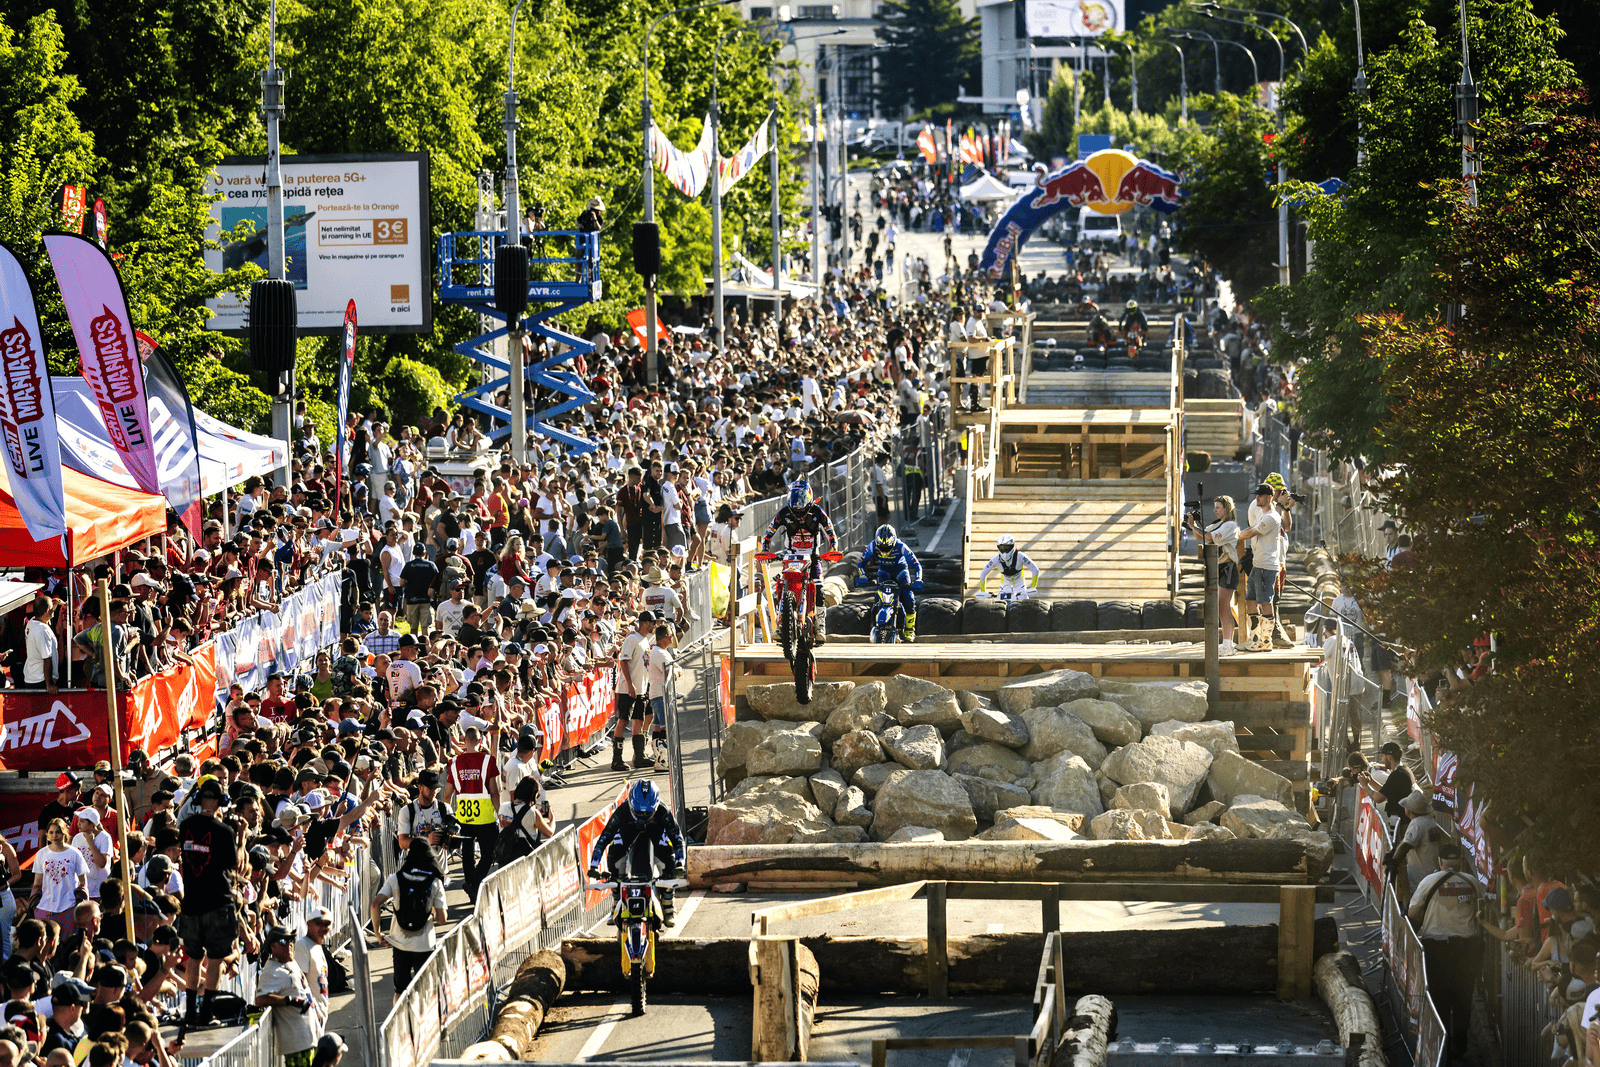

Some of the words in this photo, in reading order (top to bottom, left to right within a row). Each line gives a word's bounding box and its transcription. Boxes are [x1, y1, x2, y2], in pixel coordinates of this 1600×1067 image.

[214, 175, 224, 186] O
[227, 175, 251, 186] vară
[284, 175, 294, 184] la
[297, 174, 341, 185] puterea
[343, 172, 367, 182] 5G+
[228, 190, 249, 198] cea
[252, 189, 268, 198] ma
[281, 186, 312, 199] apidă
[314, 186, 344, 199] rețea
[317, 203, 361, 211] Portează-te
[371, 203, 400, 211] Orange
[397, 305, 411, 313] aici
[95, 318, 132, 399] MANIACS
[3, 332, 38, 421] MANIACS
[120, 404, 145, 446] LIVE
[23, 426, 44, 473] LIVE
[459, 799, 481, 818] 383
[631, 888, 641, 897] 17
